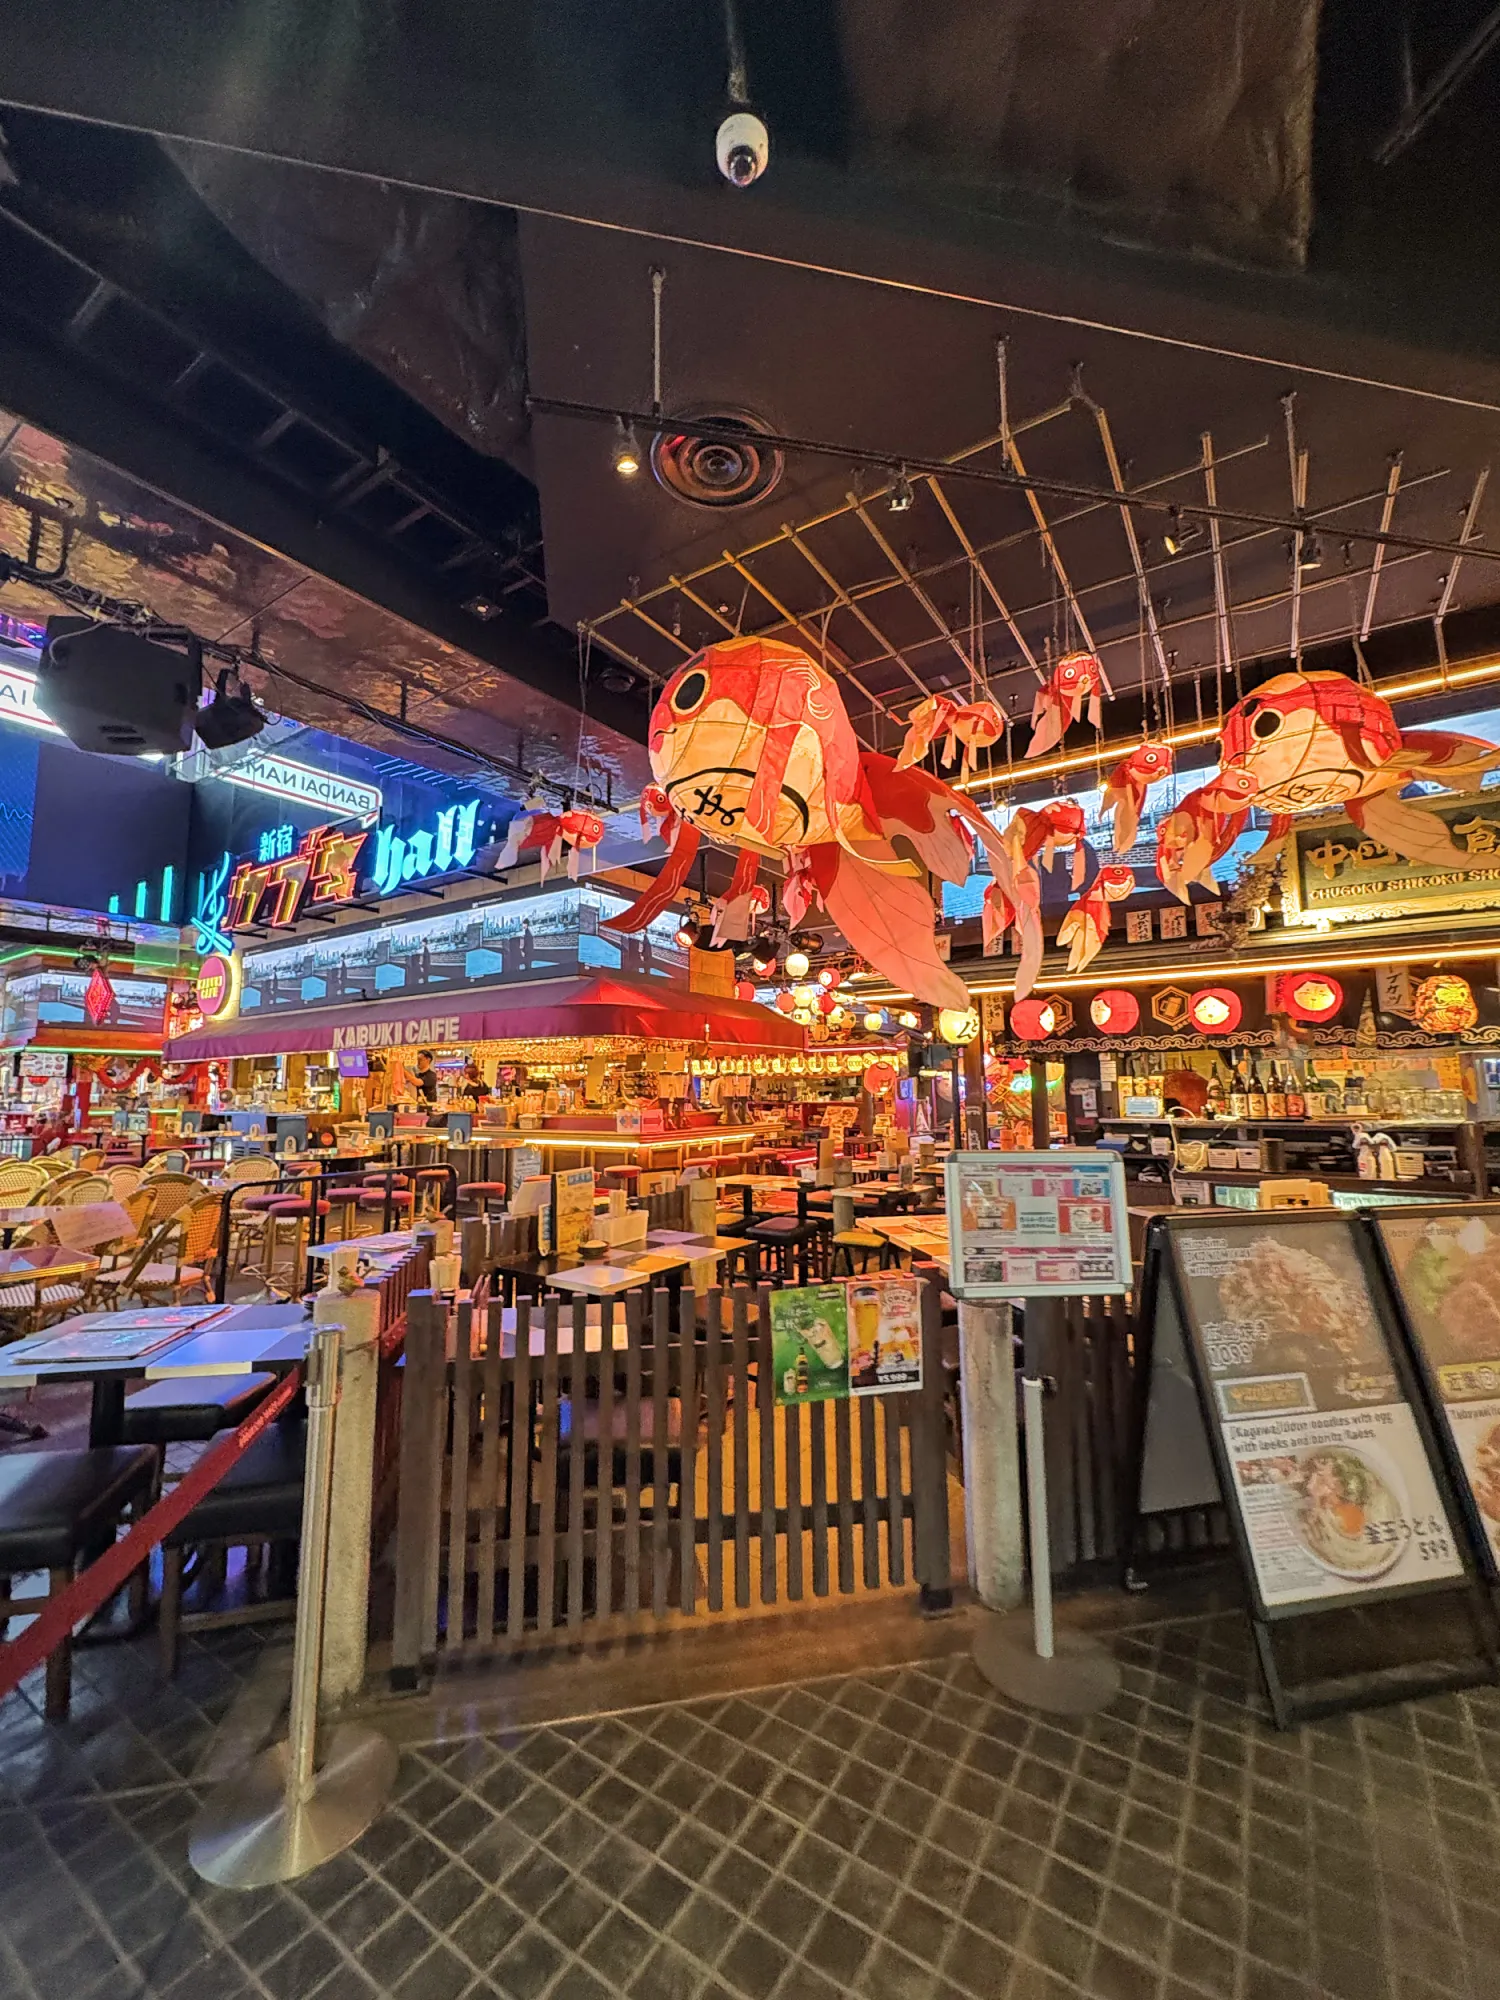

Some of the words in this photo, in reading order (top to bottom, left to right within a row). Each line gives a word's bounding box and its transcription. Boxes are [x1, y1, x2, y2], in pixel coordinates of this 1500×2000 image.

[258, 823, 293, 863] 新宿
[372, 799, 480, 896] hall
[1310, 882, 1383, 900] CHUGOKU
[1387, 872, 1464, 891] SHIKOKU
[333, 1021, 402, 1049] KABUKI
[405, 1016, 460, 1042] CAFE
